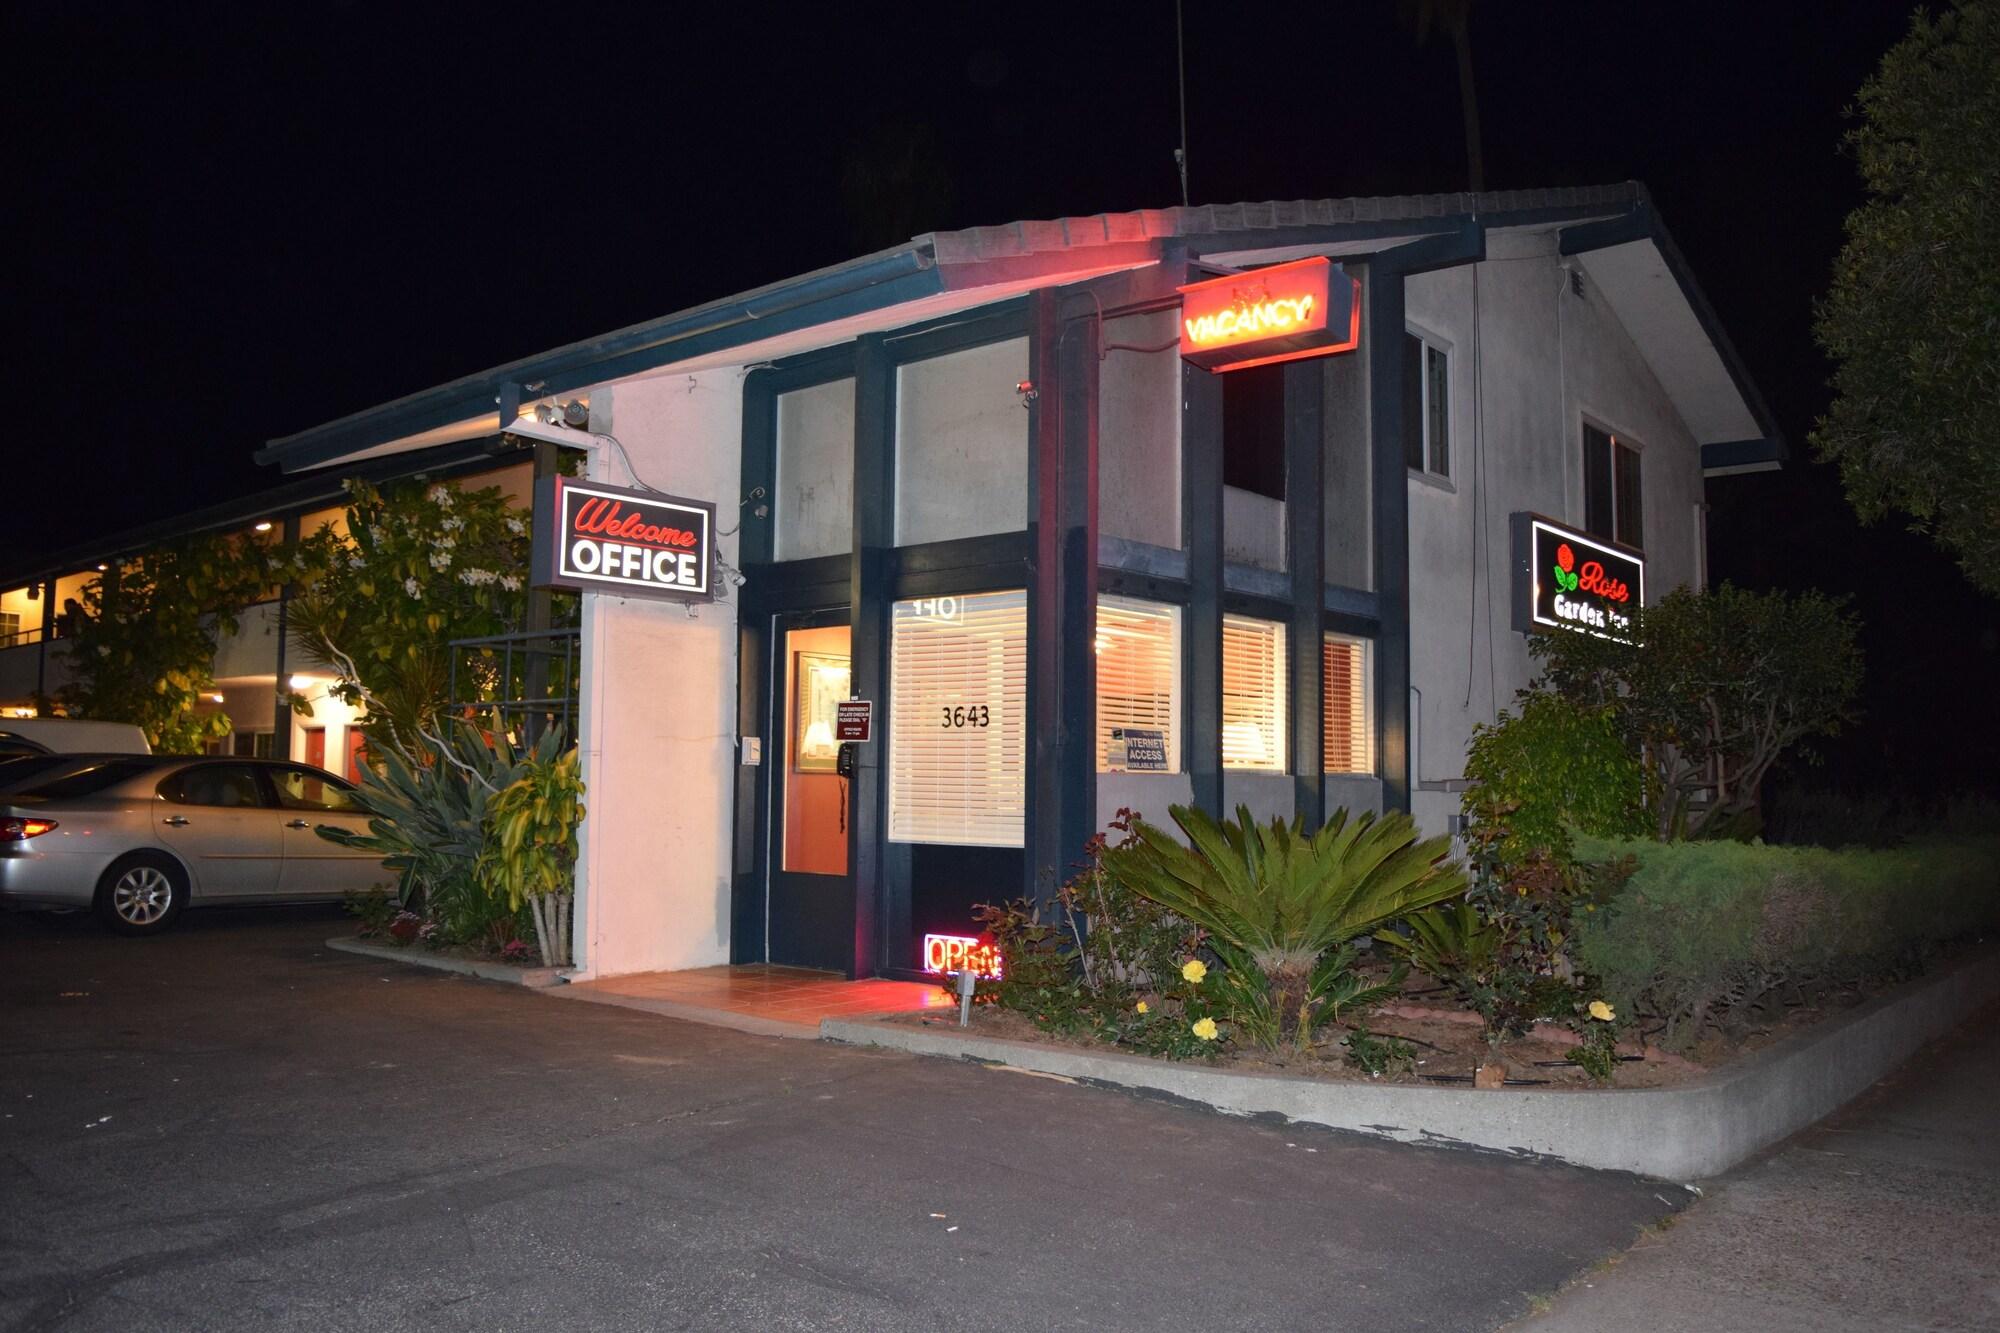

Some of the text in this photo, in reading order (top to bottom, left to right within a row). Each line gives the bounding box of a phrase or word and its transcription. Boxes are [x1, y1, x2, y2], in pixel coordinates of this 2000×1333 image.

[1185, 294, 1314, 343] VACANCY
[574, 497, 697, 547] Welcome
[572, 539, 697, 586] OFFICE
[1579, 561, 1629, 602] Rose
[1554, 594, 1605, 628] Garden
[942, 705, 989, 728] 3643
[1126, 738, 1163, 748] INTERNET
[1130, 750, 1163, 760] ACCESS
[928, 939, 999, 976] OPEN
